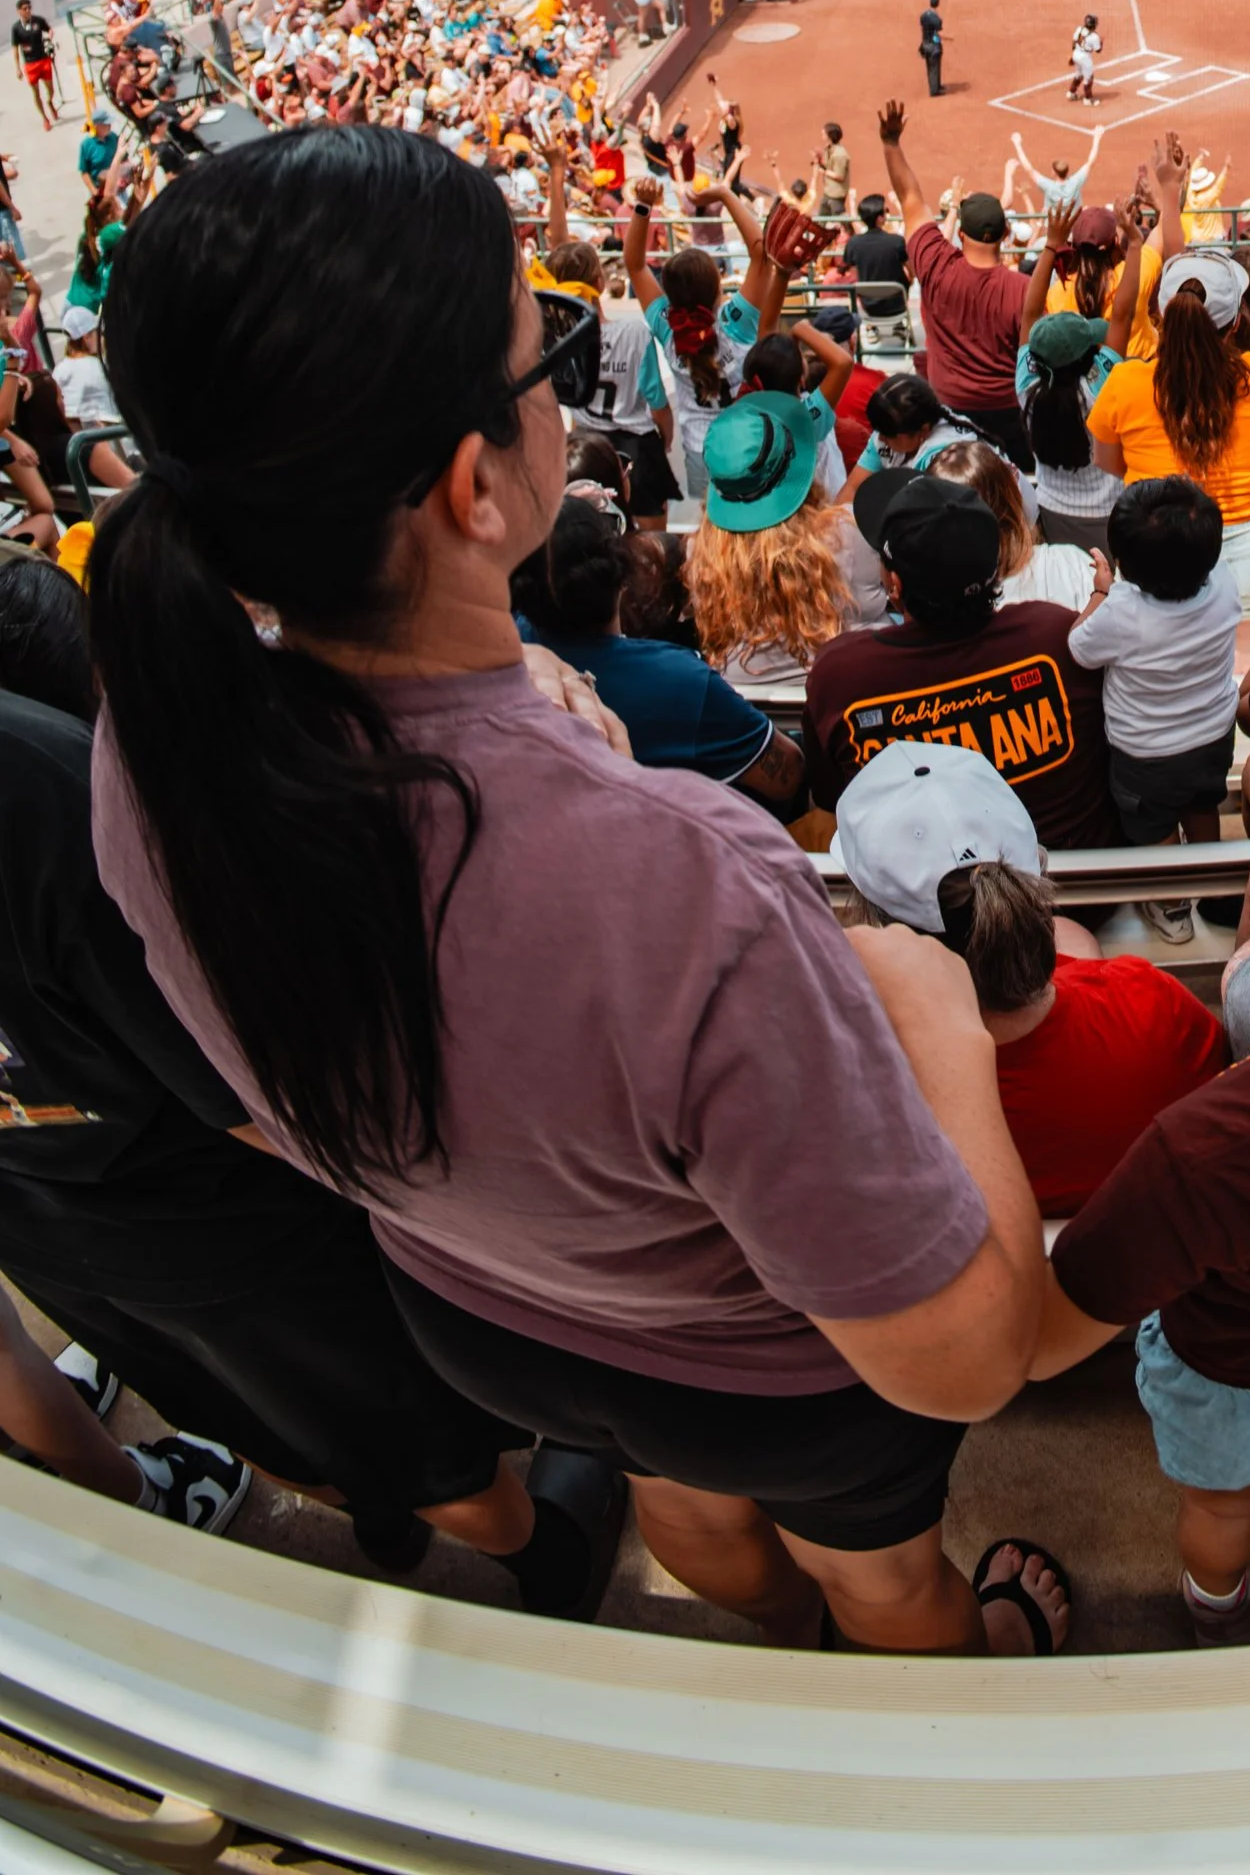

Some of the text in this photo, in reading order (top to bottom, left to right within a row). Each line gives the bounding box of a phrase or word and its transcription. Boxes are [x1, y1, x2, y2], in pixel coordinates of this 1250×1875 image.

[859, 711, 881, 726] EST
[891, 688, 1007, 726] California
[990, 697, 1063, 770] ANA
